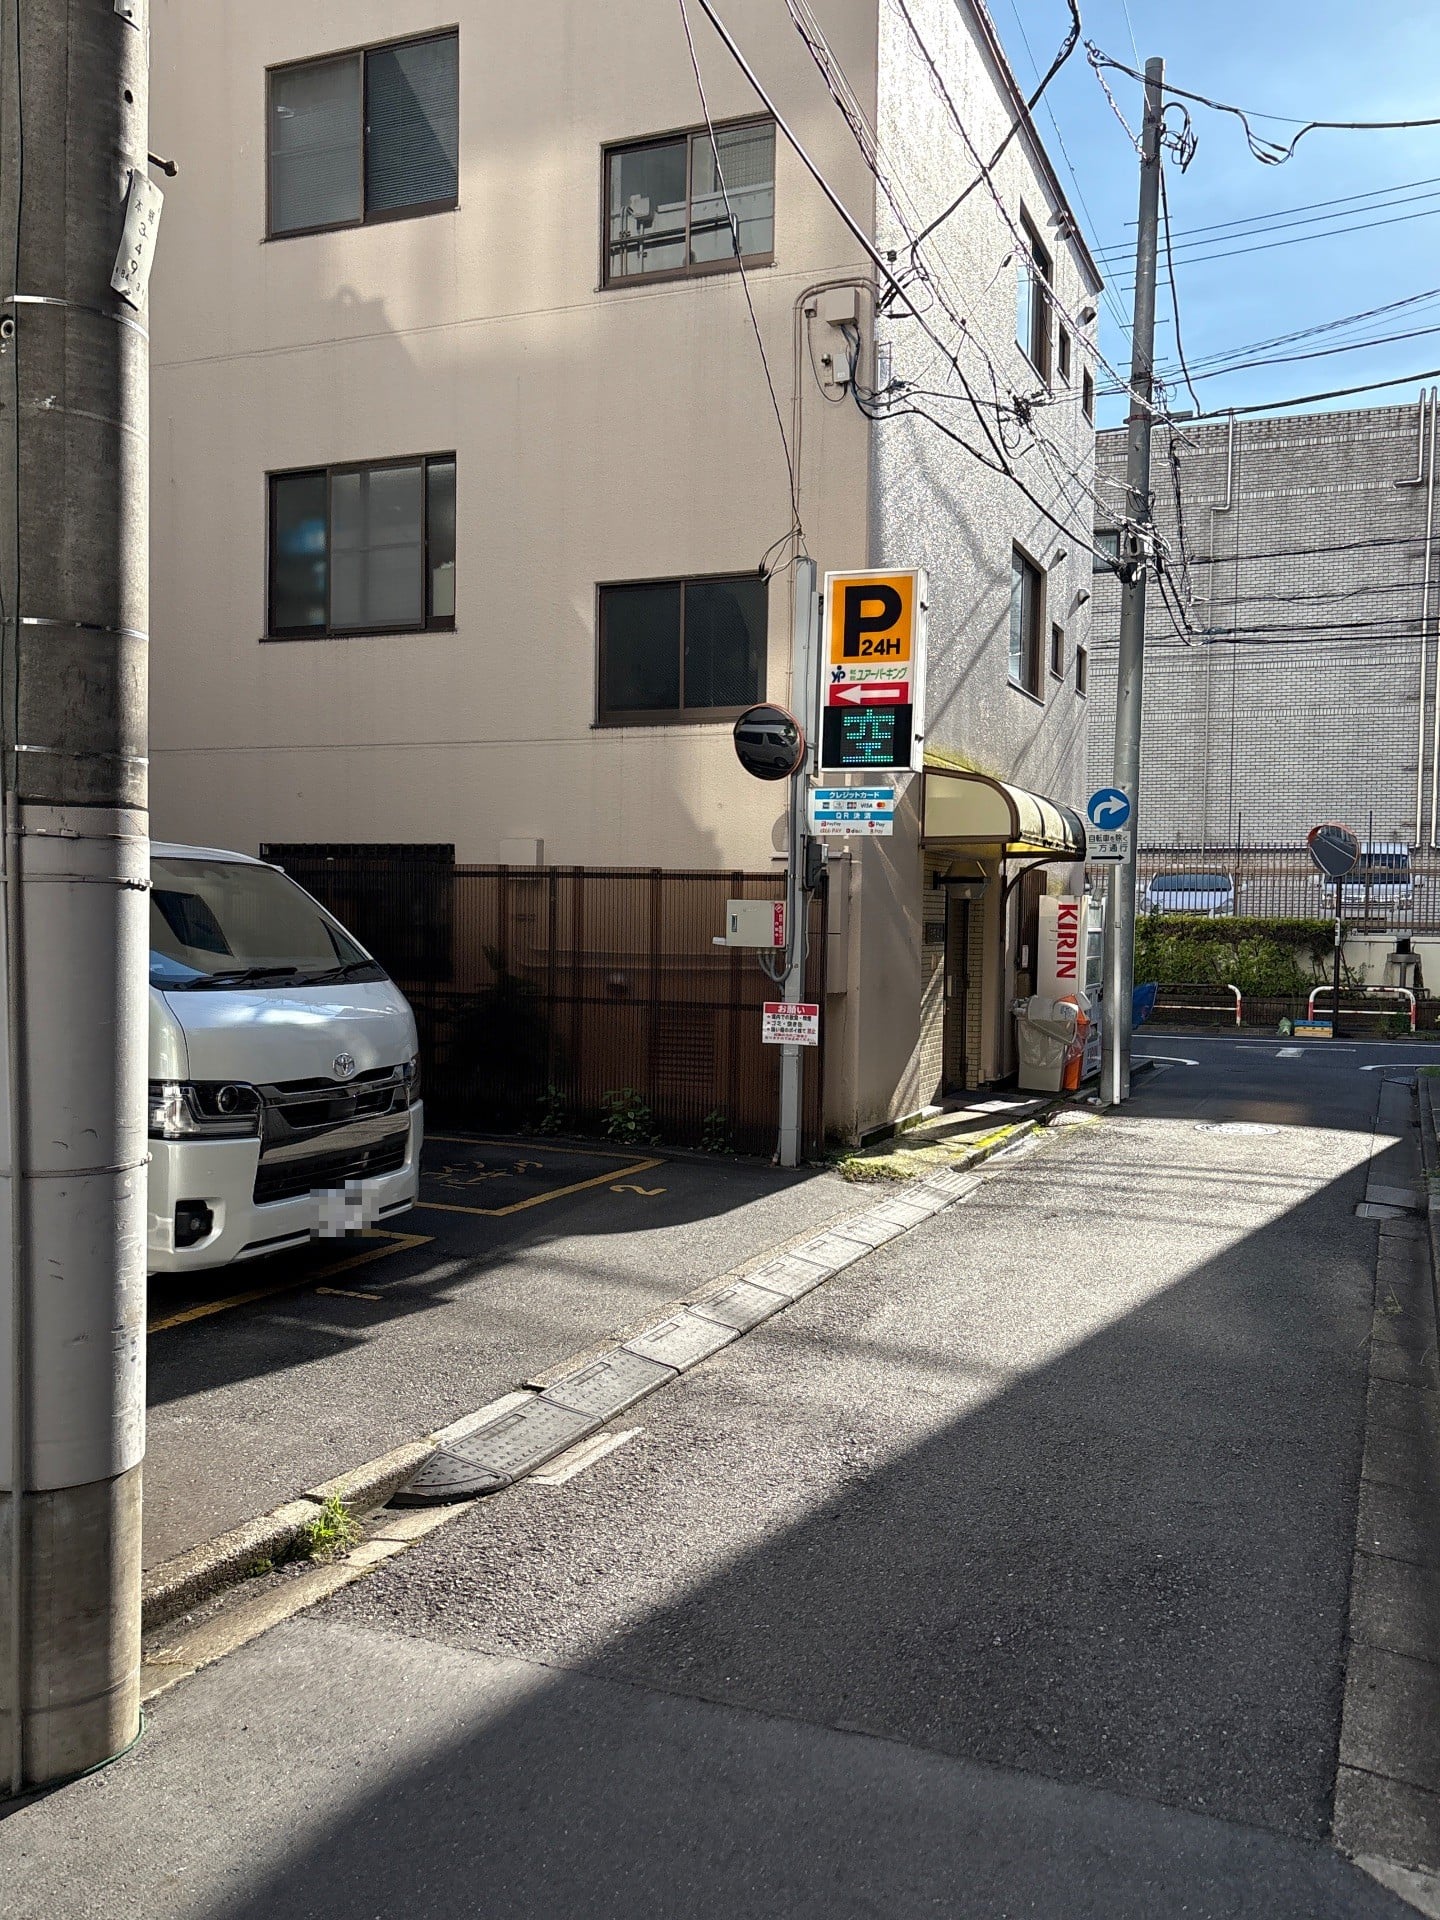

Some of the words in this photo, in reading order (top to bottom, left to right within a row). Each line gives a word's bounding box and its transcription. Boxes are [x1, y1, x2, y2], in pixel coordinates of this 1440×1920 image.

[843, 584, 903, 658] P
[861, 638, 901, 657] 24H
[843, 708, 895, 763] 空
[1088, 834, 1128, 843] 自転車を除く
[1088, 843, 1128, 853] 一方通行
[1056, 904, 1078, 979] KIRIN
